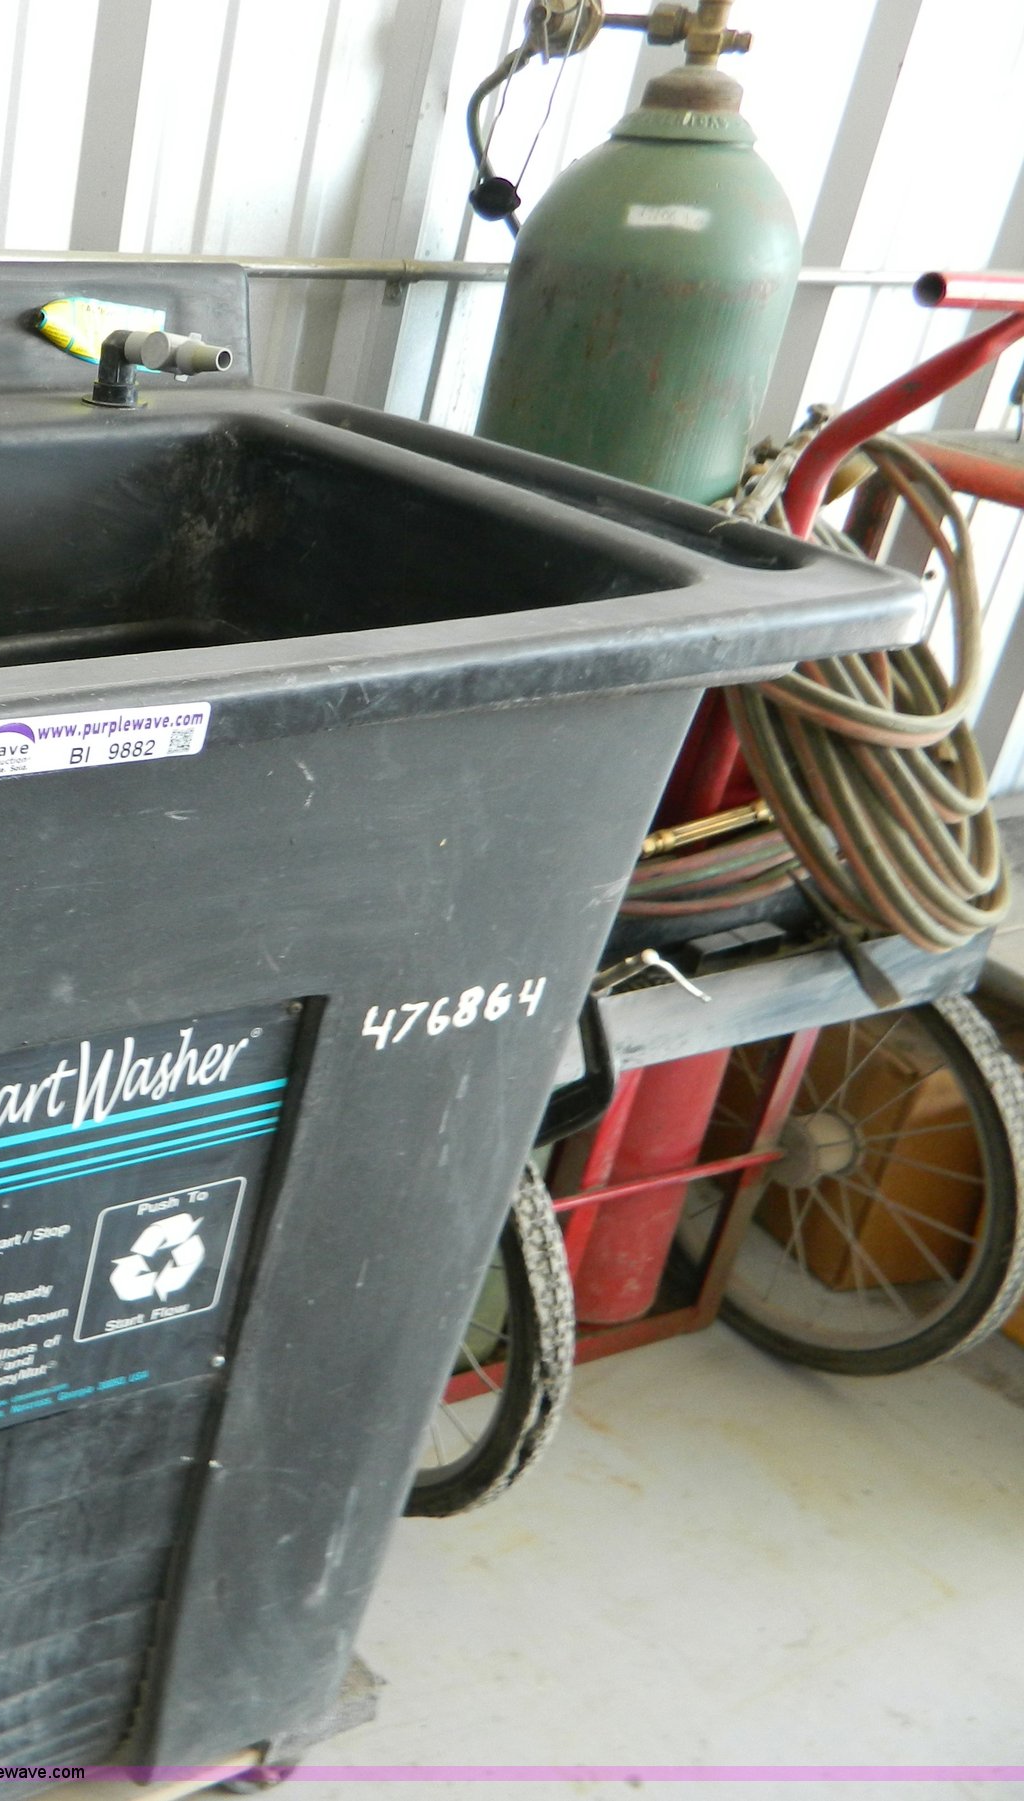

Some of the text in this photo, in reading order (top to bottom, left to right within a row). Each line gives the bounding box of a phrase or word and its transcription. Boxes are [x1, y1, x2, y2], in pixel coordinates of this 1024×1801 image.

[37, 711, 204, 740] www.purplewave.com
[107, 739, 156, 760] 9882
[362, 976, 547, 1050] 476864
[136, 1190, 210, 1216] Push To
[104, 1303, 191, 1332] Start Flow
[43, 1334, 63, 1349] of
